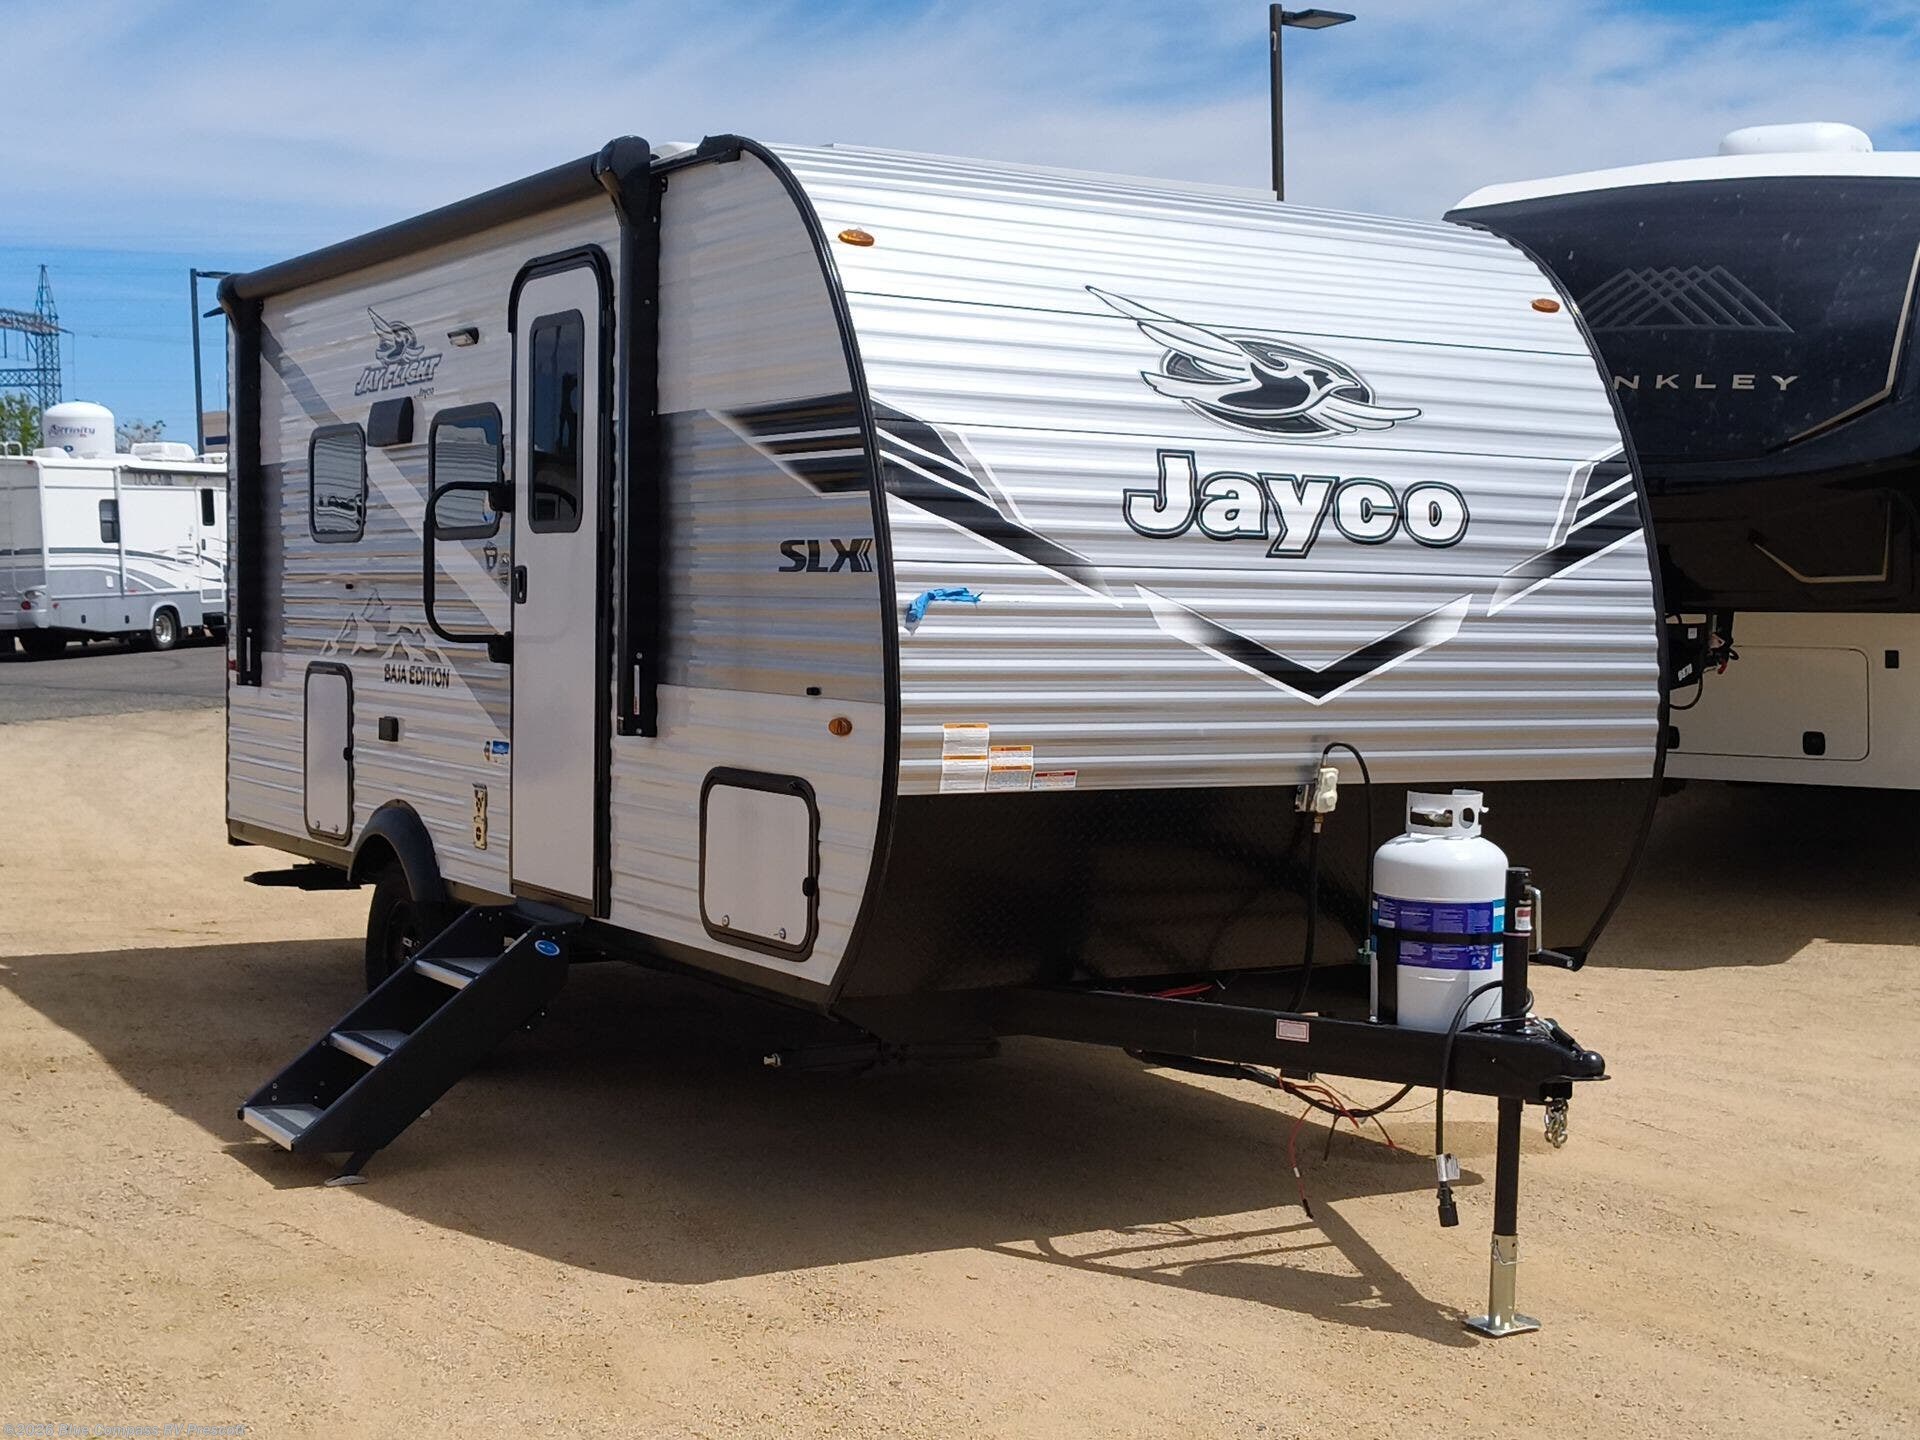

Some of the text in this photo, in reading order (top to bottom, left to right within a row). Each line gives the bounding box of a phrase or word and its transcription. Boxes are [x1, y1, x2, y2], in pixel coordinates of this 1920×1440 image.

[1123, 448, 1470, 559] Jayco
[779, 539, 873, 572] SLX
[384, 663, 450, 689] BAJA EDITION
